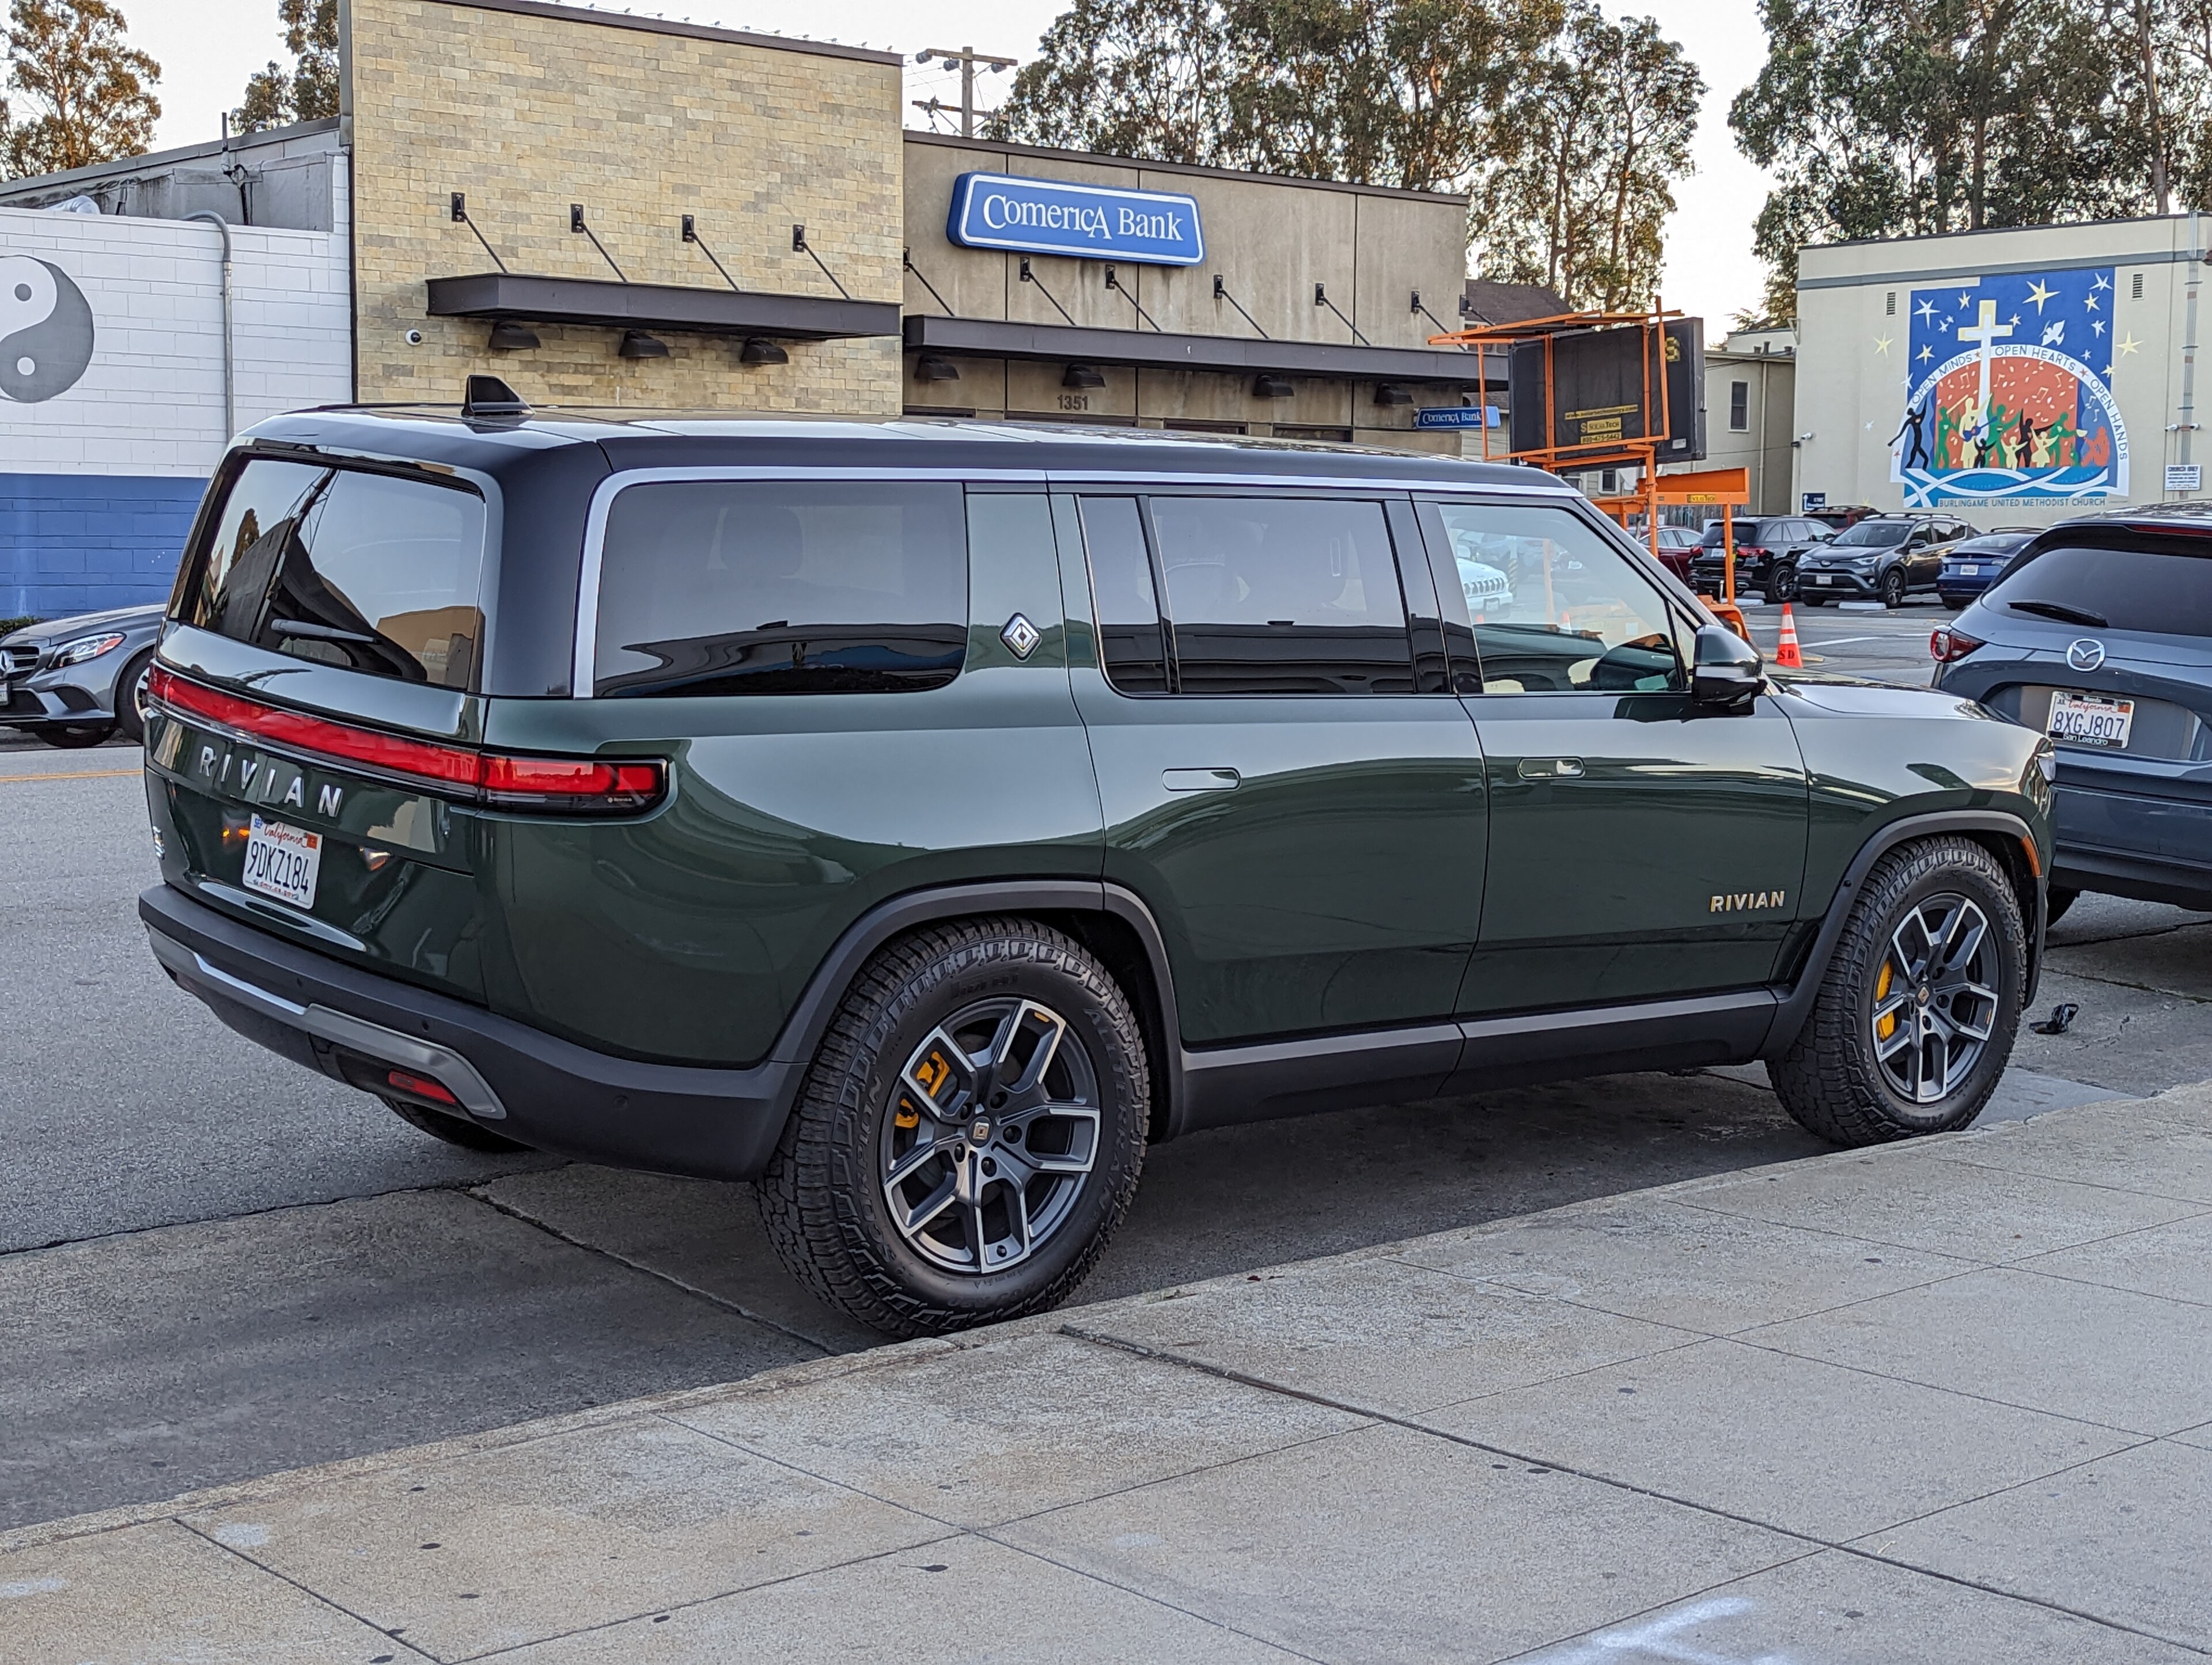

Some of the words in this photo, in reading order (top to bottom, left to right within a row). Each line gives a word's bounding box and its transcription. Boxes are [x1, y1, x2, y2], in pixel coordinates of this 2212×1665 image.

[1117, 207, 1184, 241] Bank
[1057, 394, 1088, 410] 1351
[1912, 375, 1937, 404] OPEN
[1939, 354, 1972, 376] MINDS
[1995, 346, 2027, 356] OPEN
[2032, 347, 2076, 371] HEARTS
[2090, 378, 2115, 411] OPEN
[2110, 413, 2128, 460] HANDS
[1461, 411, 1482, 422] Bank
[1939, 499, 1989, 507] BURLINGAME
[1991, 499, 2019, 507] UNITED
[2022, 498, 2069, 507] METHODIST
[2073, 498, 2105, 506] CHURCH
[2069, 699, 2118, 714] California
[2053, 711, 2125, 739] 8XGJ807
[2063, 733, 2077, 742] San
[2078, 734, 2108, 746] Leandro
[199, 745, 343, 818] RIVIAN
[264, 821, 308, 848] California
[247, 841, 310, 895] 9DKZ184
[1710, 890, 1785, 913] RIVIAN
